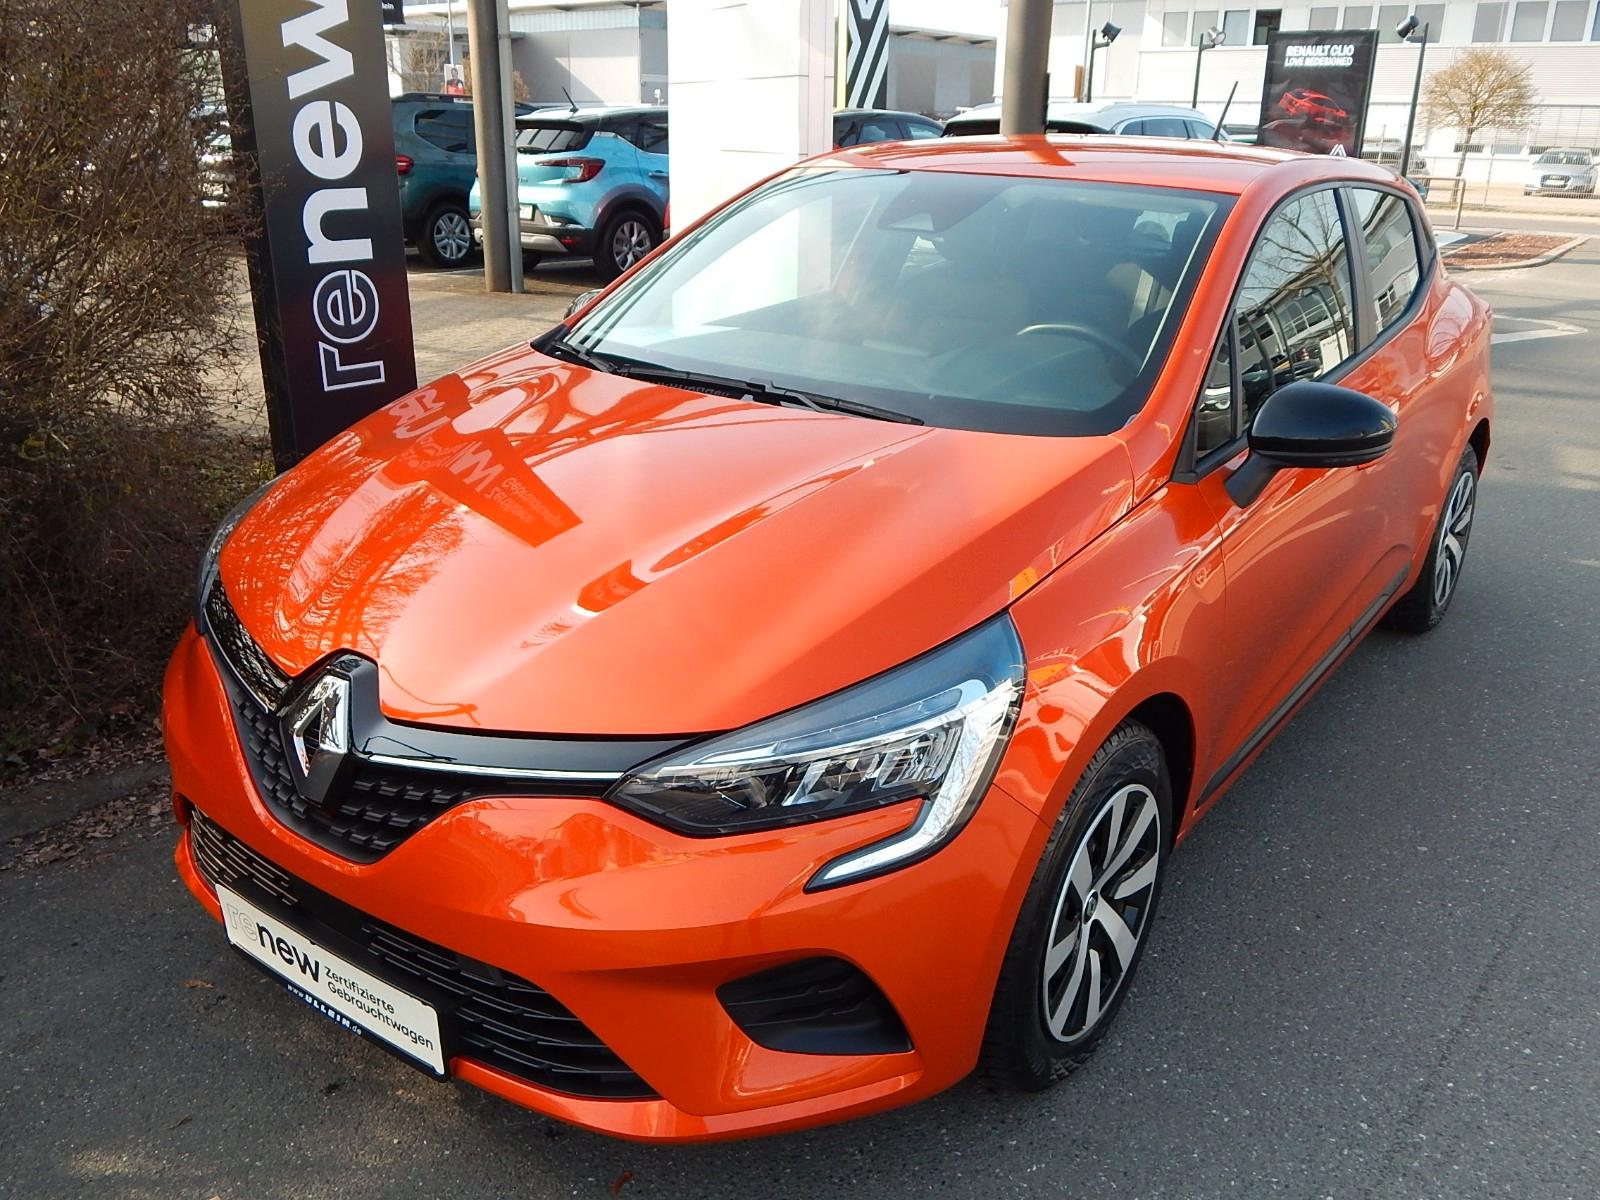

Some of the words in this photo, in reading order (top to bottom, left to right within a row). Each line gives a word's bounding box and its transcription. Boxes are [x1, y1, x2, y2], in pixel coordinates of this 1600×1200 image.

[1284, 56, 1305, 67] LOVE
[1304, 56, 1354, 67] REDESIGNED
[1285, 45, 1331, 57] RENAULT
[1330, 44, 1355, 57] CLIO
[281, 0, 385, 392] renew
[226, 903, 320, 983] renew
[324, 965, 395, 1015] Zertifizierte
[327, 981, 434, 1051] Gebrauchtwagen
